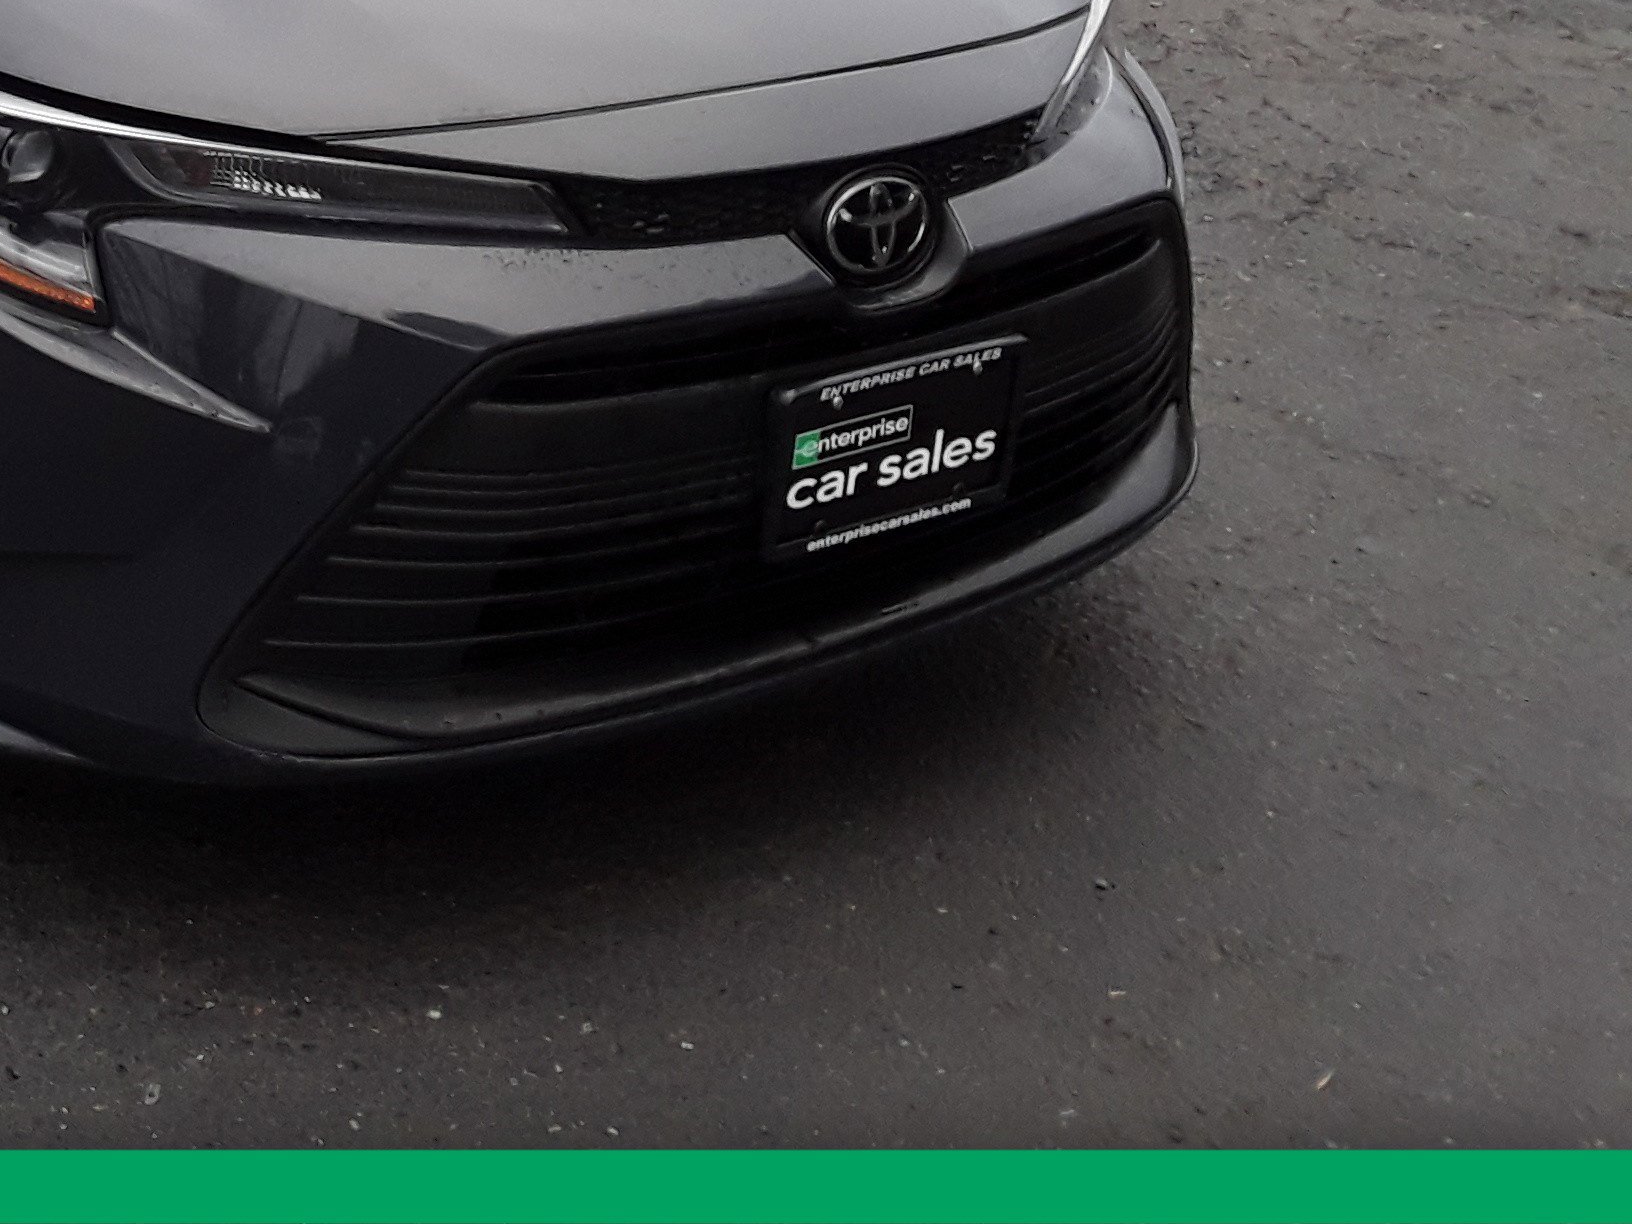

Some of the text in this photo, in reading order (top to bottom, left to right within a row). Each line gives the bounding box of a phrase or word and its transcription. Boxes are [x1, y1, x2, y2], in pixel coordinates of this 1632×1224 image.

[820, 347, 1002, 403] ENTERPRISE CAR SALES
[800, 416, 909, 458] enterprise
[786, 428, 997, 509] car sales
[806, 498, 972, 552] enterprisecarsales.com
